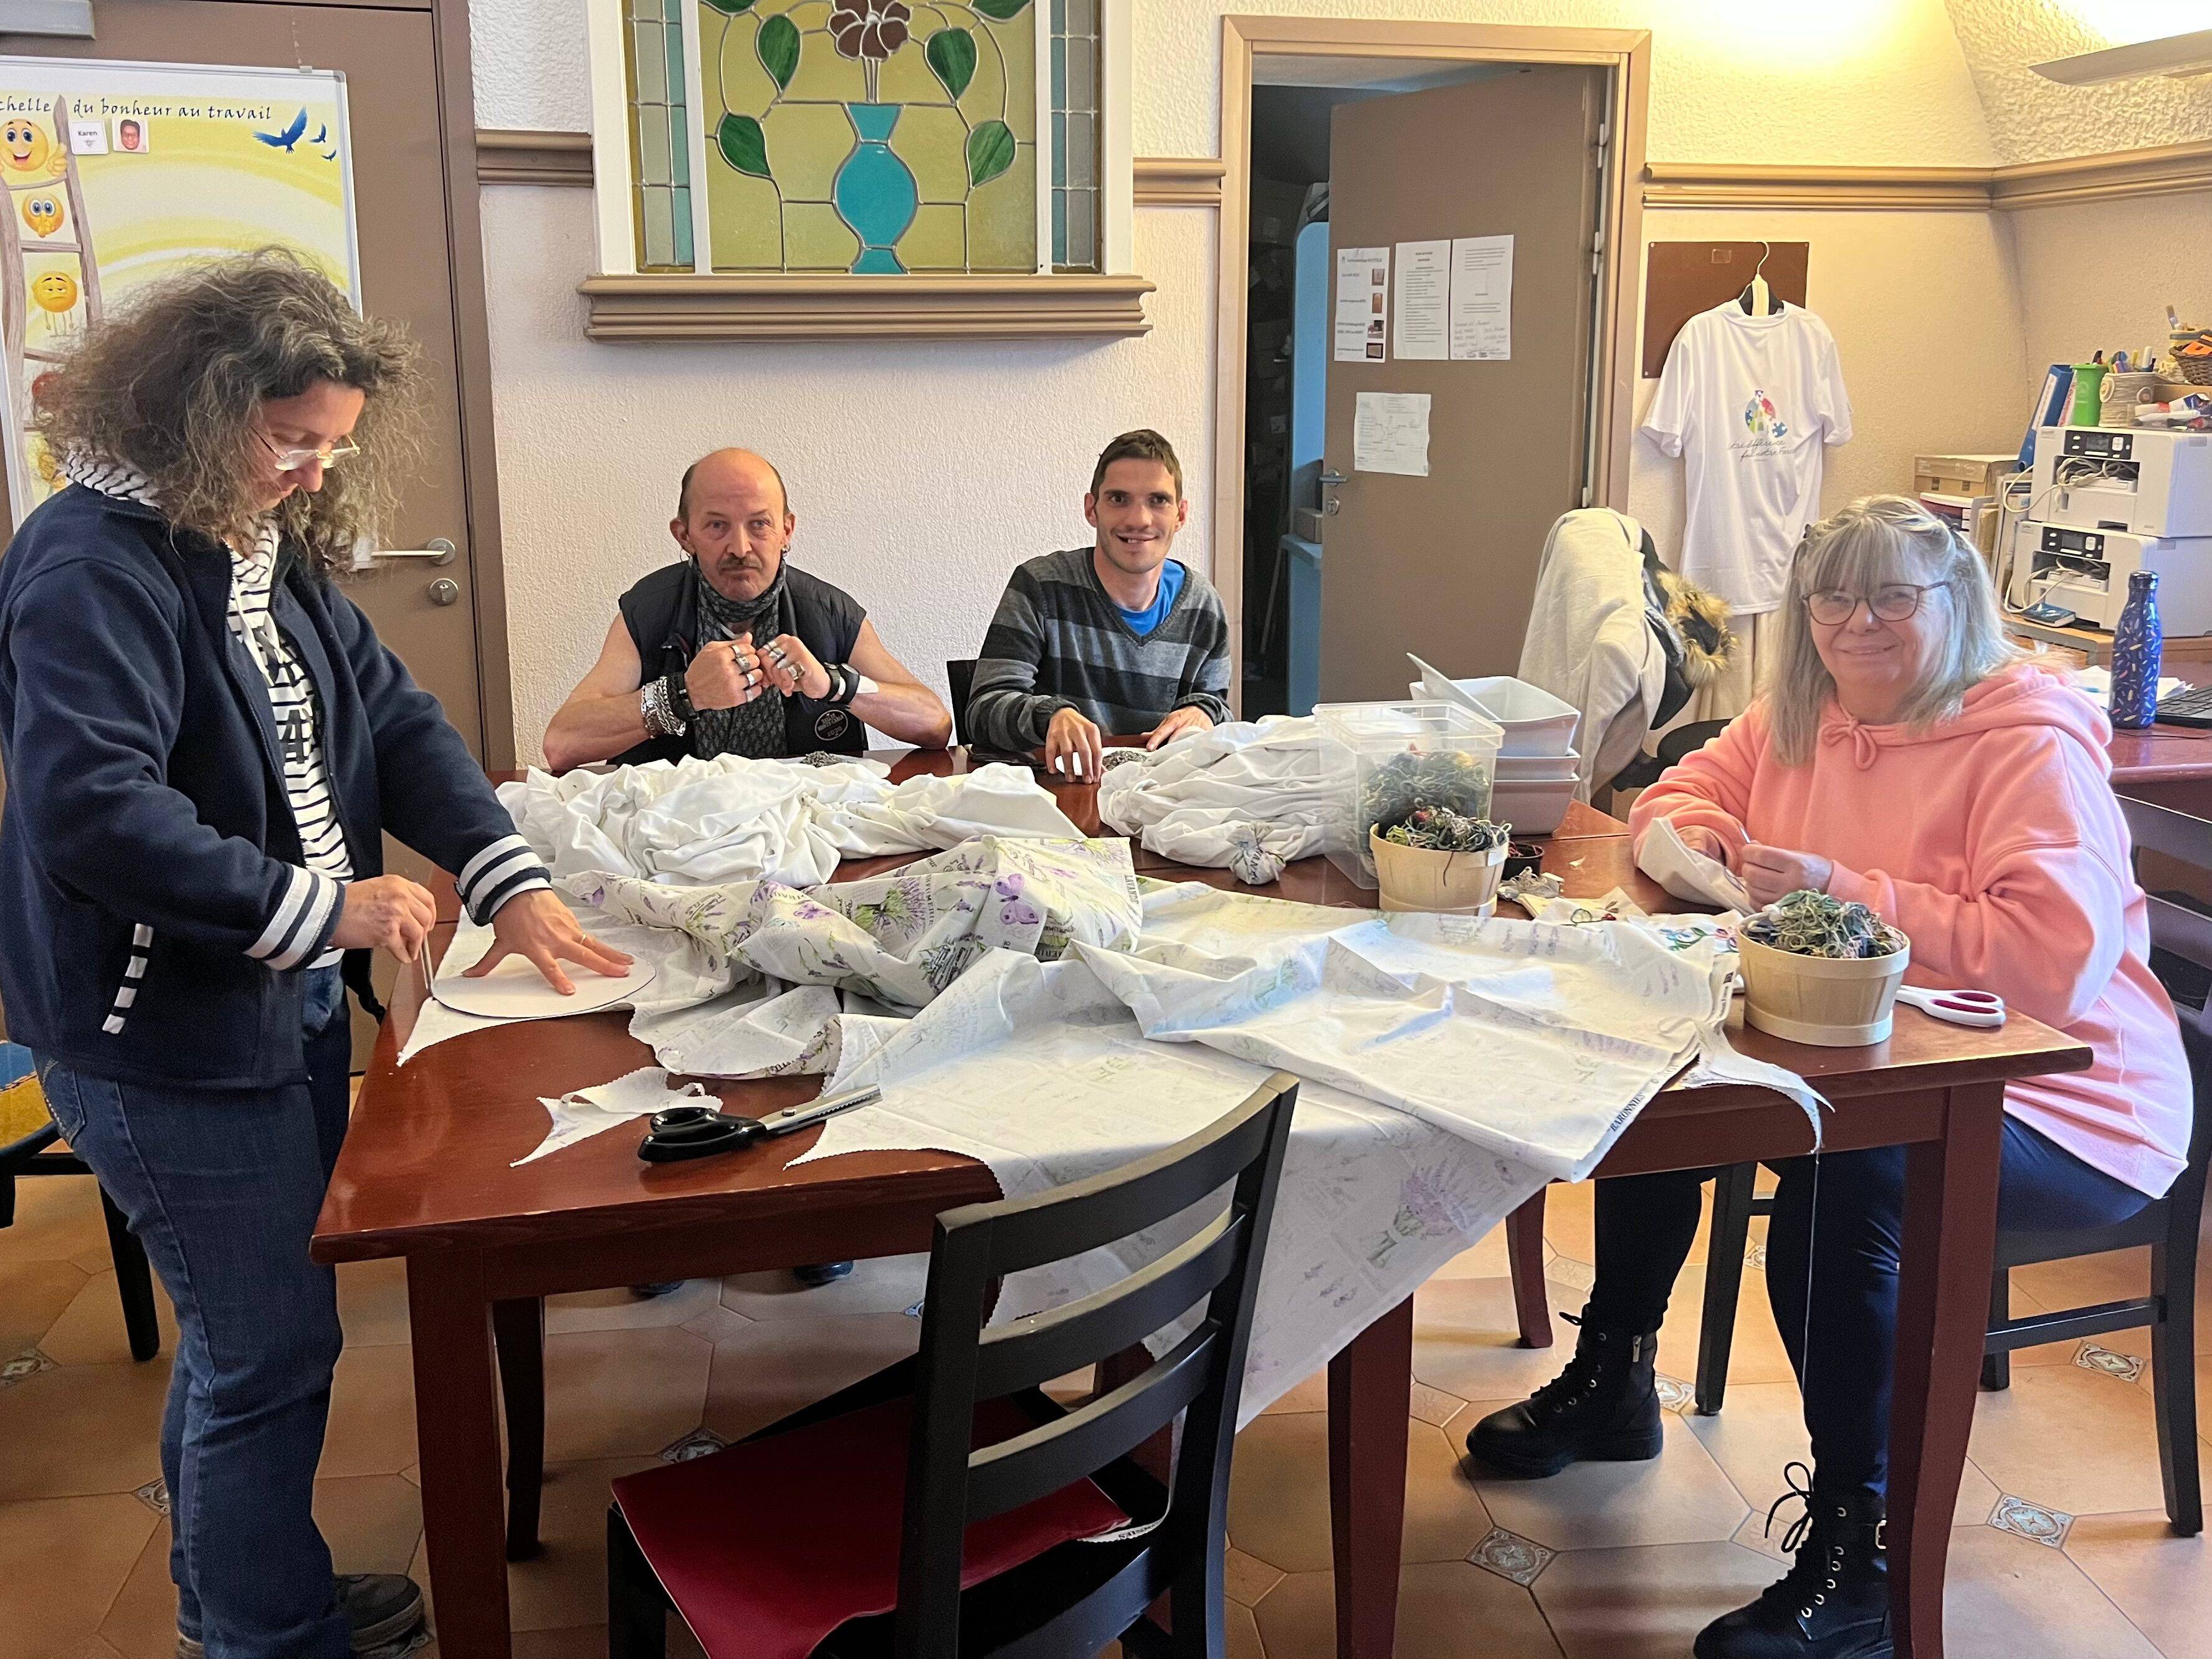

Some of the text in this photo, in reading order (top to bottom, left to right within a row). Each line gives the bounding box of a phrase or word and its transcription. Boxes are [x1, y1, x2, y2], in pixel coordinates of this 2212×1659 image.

[74, 99, 93, 118] du
[100, 98, 172, 115] bonheur
[179, 107, 200, 117] au
[207, 105, 272, 120] travail
